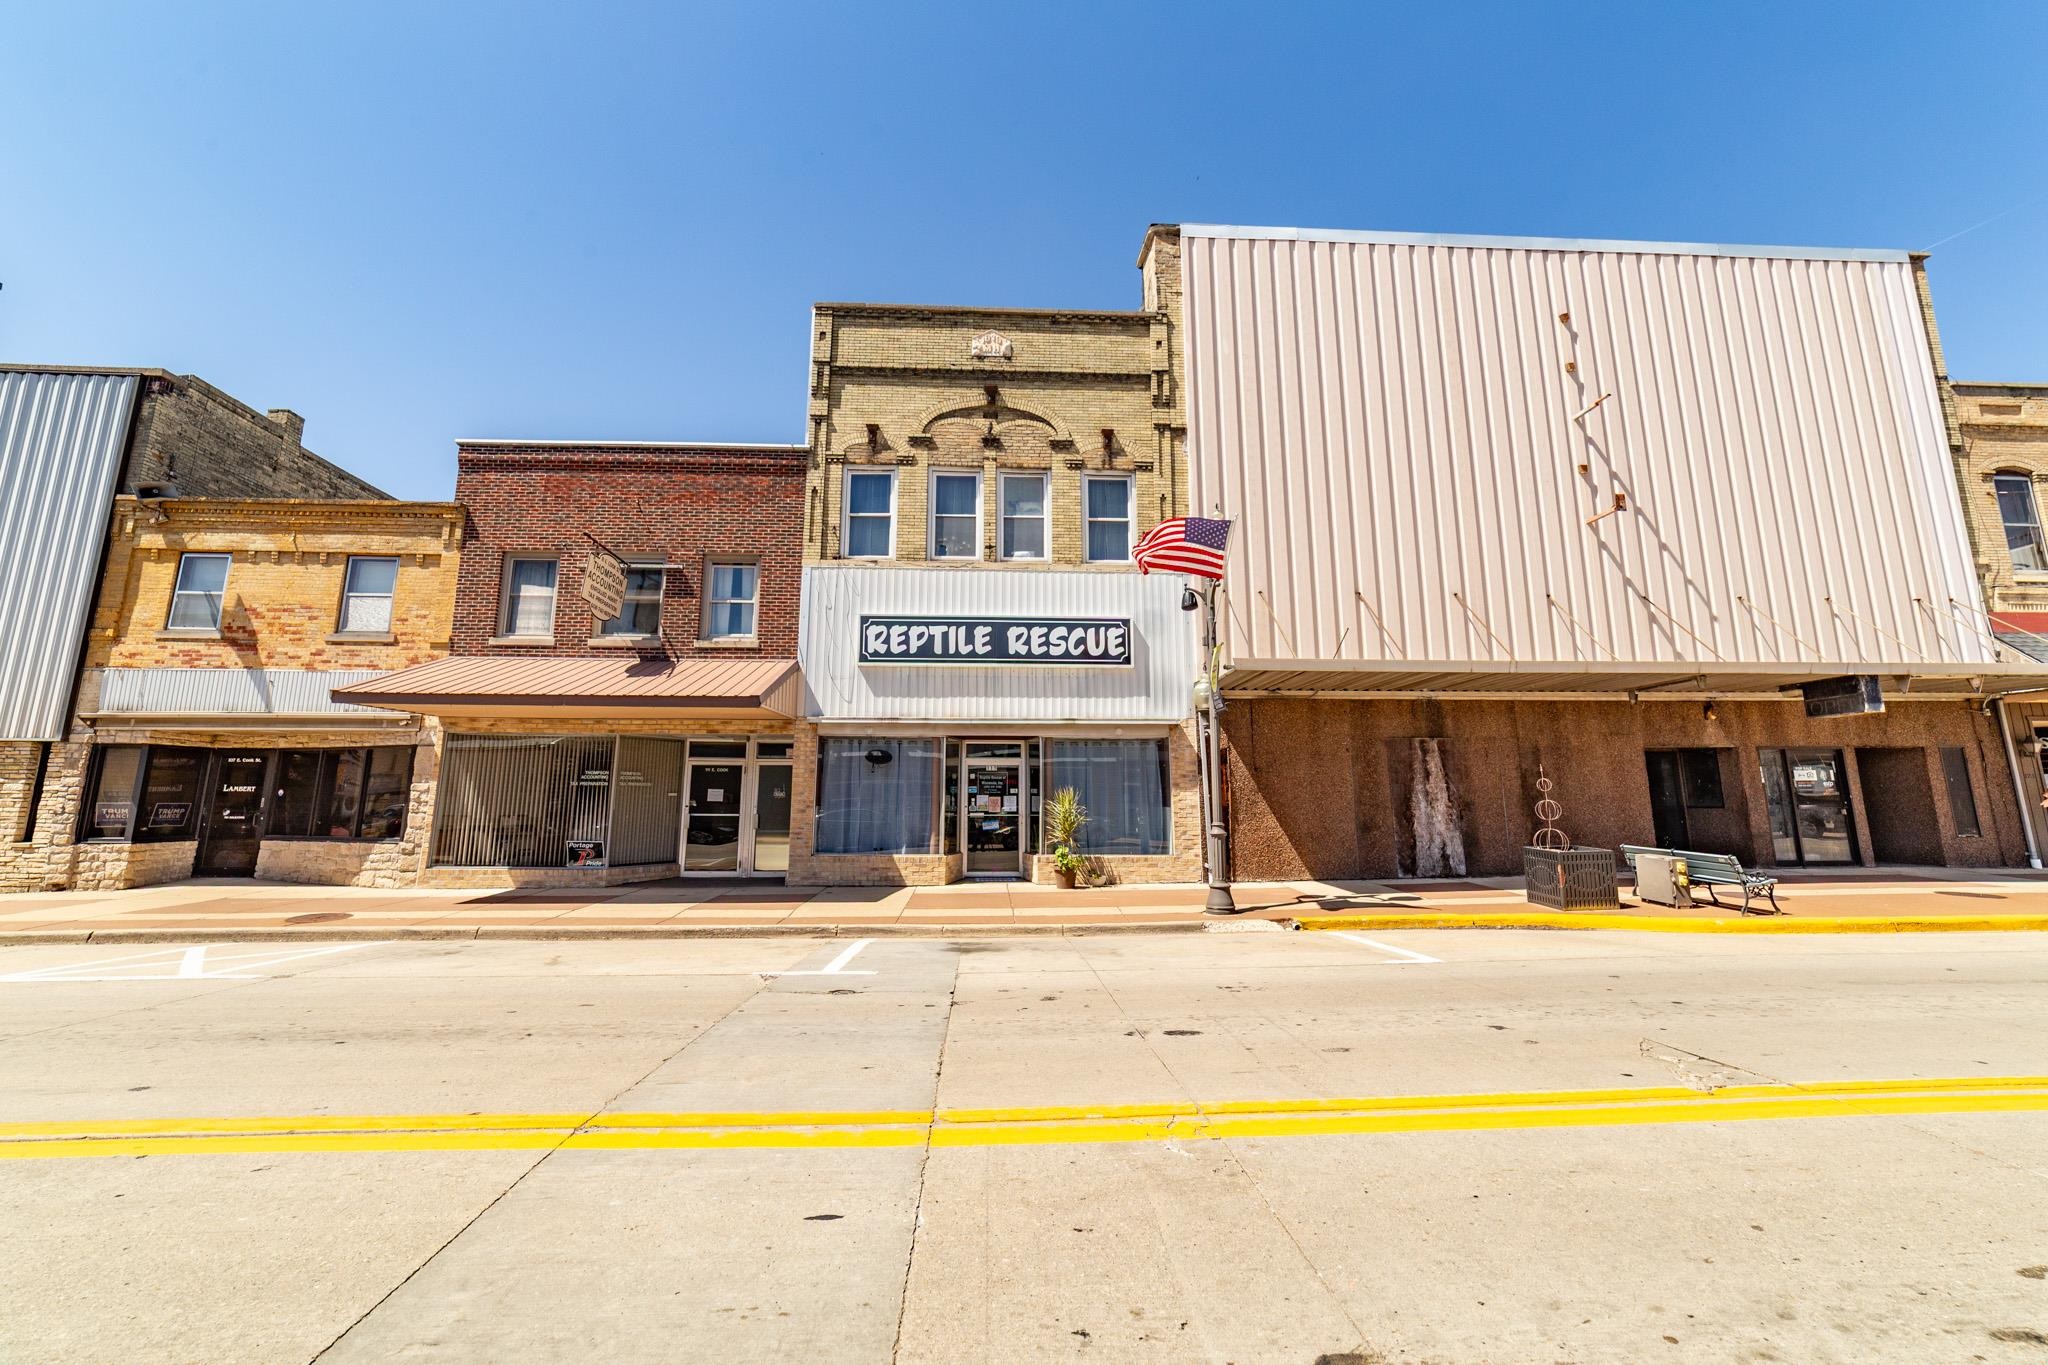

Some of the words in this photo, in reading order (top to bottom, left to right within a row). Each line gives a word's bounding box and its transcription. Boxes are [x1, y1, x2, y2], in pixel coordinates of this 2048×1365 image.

[588, 571, 624, 598] ACCOUNTING
[593, 561, 623, 588] THOMPSON
[596, 596, 618, 612] PREPARATION
[866, 624, 993, 655] REPTILE
[1006, 626, 1126, 656] RESCUE
